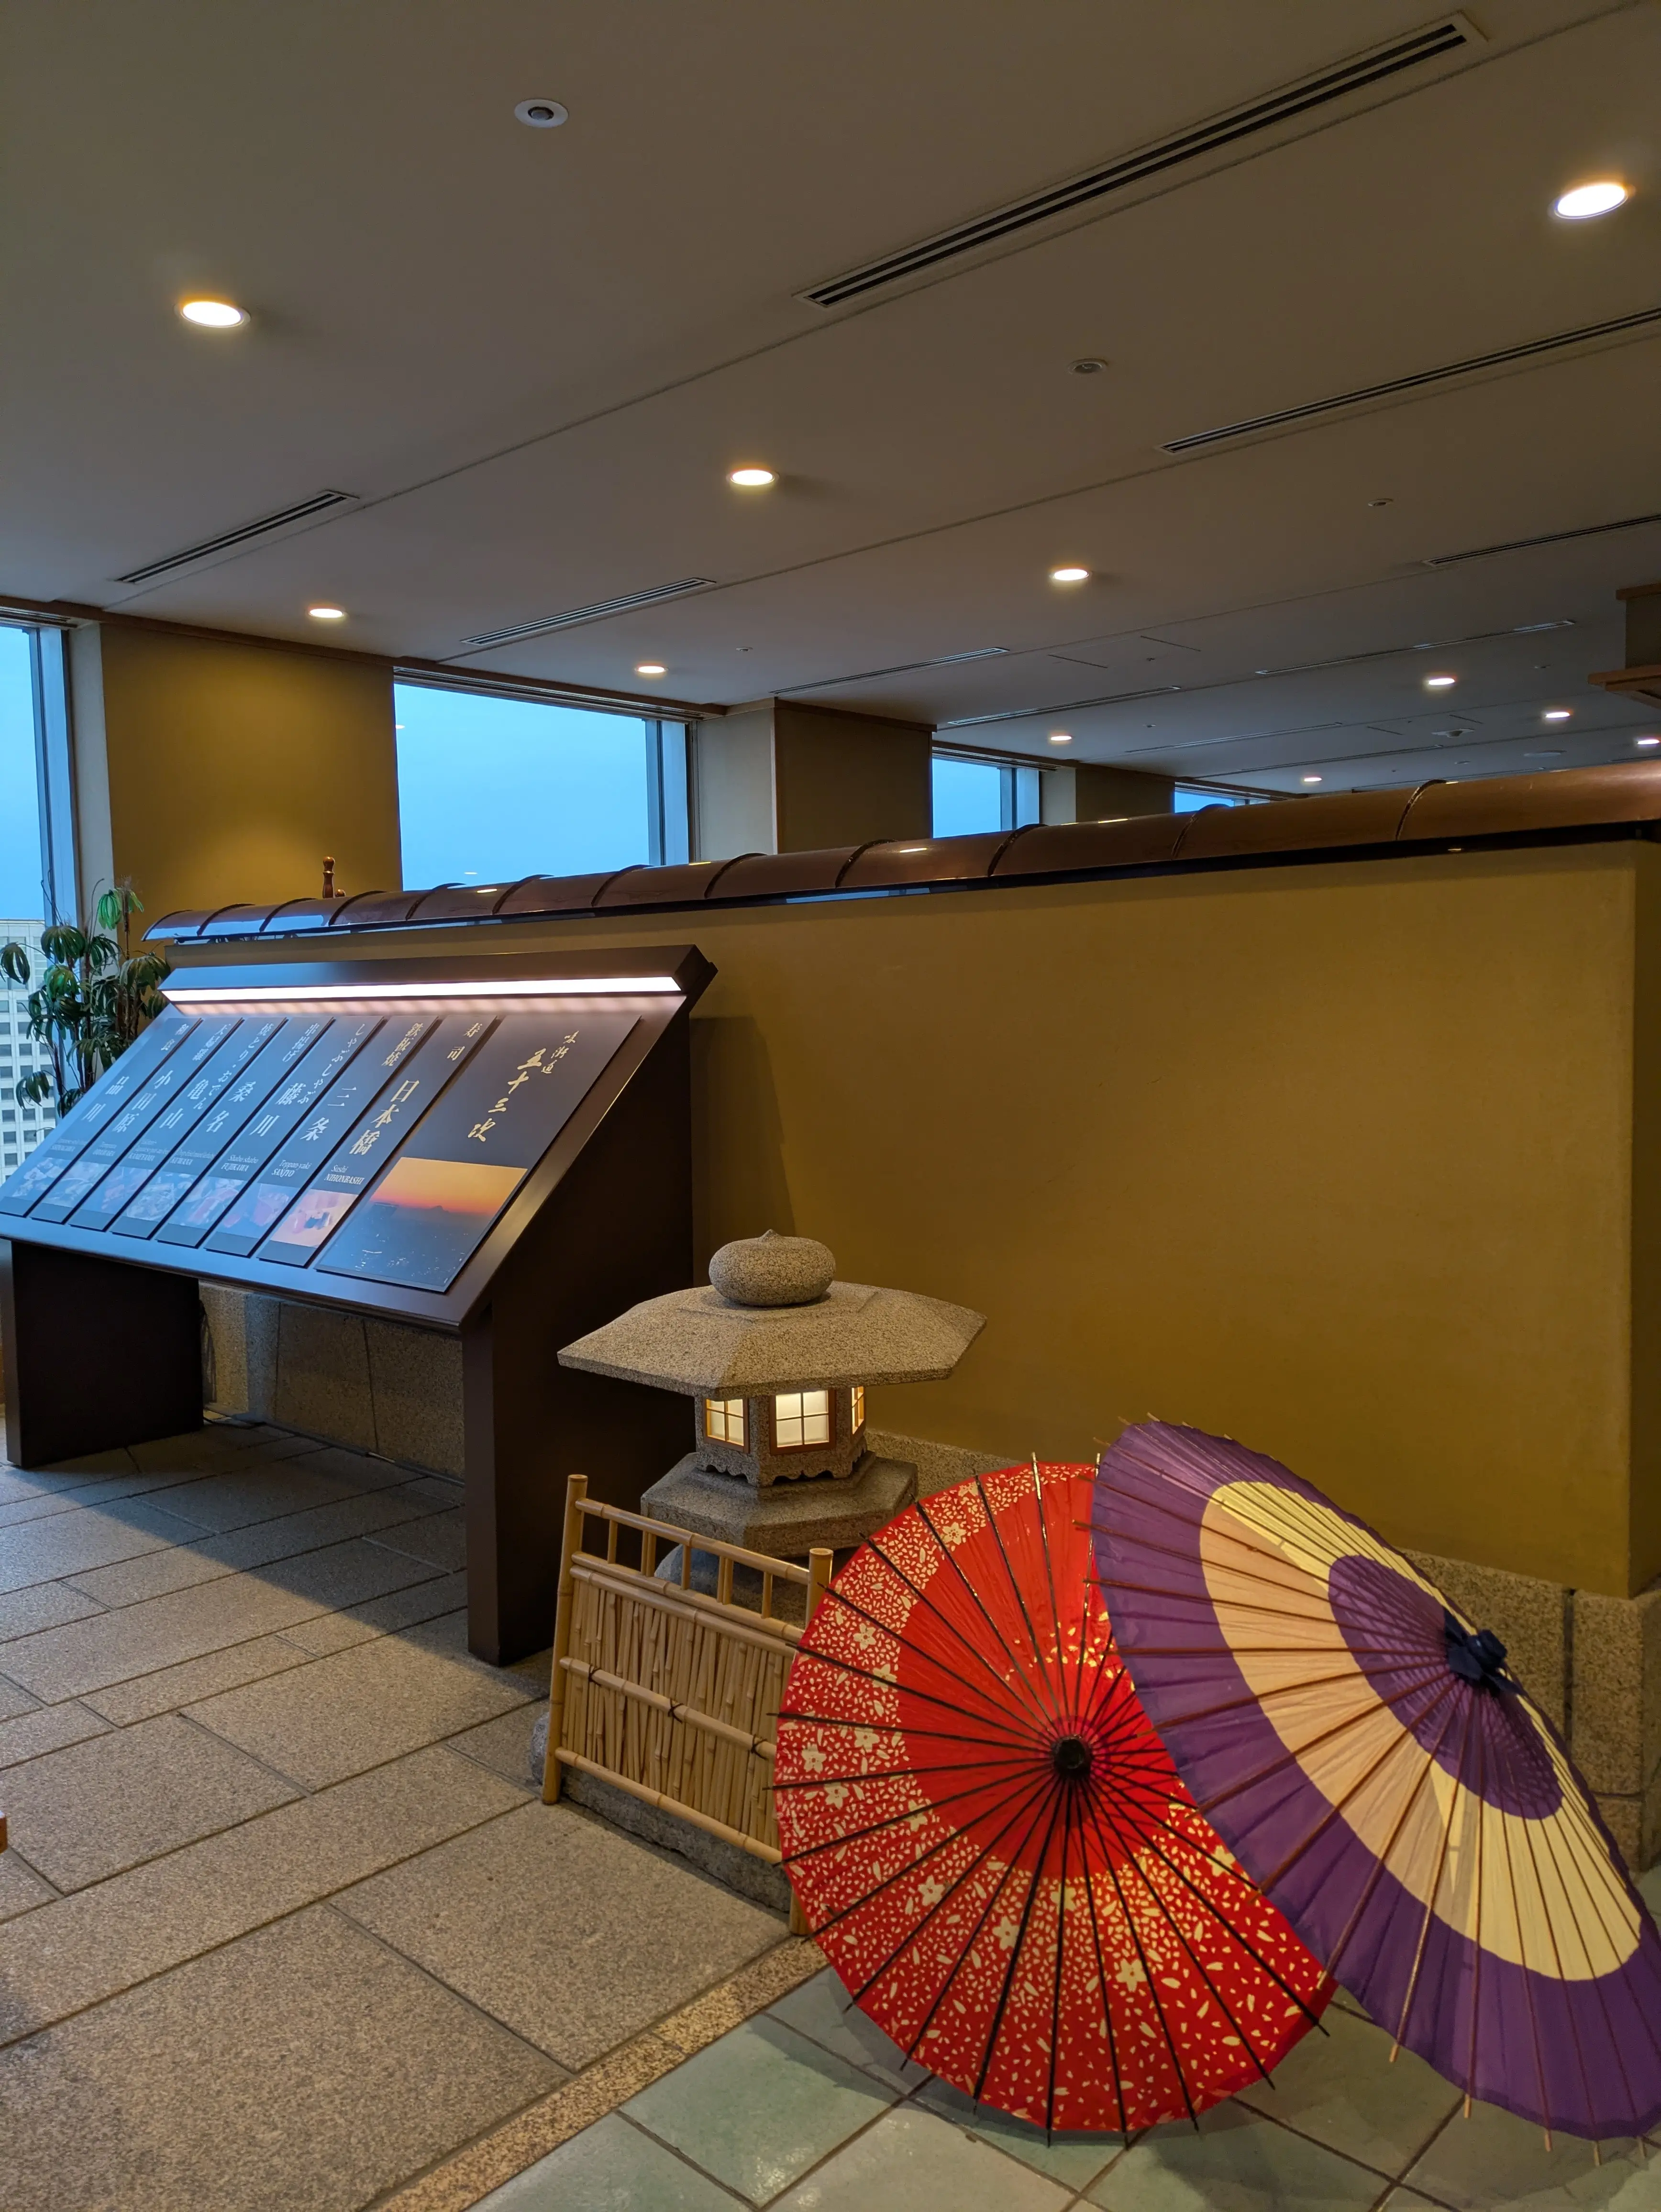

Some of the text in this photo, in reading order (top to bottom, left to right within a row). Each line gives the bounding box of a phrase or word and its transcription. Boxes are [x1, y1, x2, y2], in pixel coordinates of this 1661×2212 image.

[282, 1023, 320, 1062] 串揚げ
[298, 1024, 365, 1104] しゃぶしゃぶ
[381, 1023, 424, 1066] 鉄板焼
[447, 1022, 482, 1061] 寿司
[81, 1076, 129, 1122] 品川
[112, 1070, 173, 1133] 小田原
[159, 1079, 209, 1129] 亀山
[206, 1081, 256, 1133] 桑名
[249, 1083, 306, 1137] 藤川
[300, 1086, 357, 1141] 三条
[349, 1079, 420, 1155] 日本橋
[467, 1048, 546, 1142] 五十三次
[324, 1173, 365, 1185] NIHONBASHI
[331, 1164, 349, 1173] Sushi
